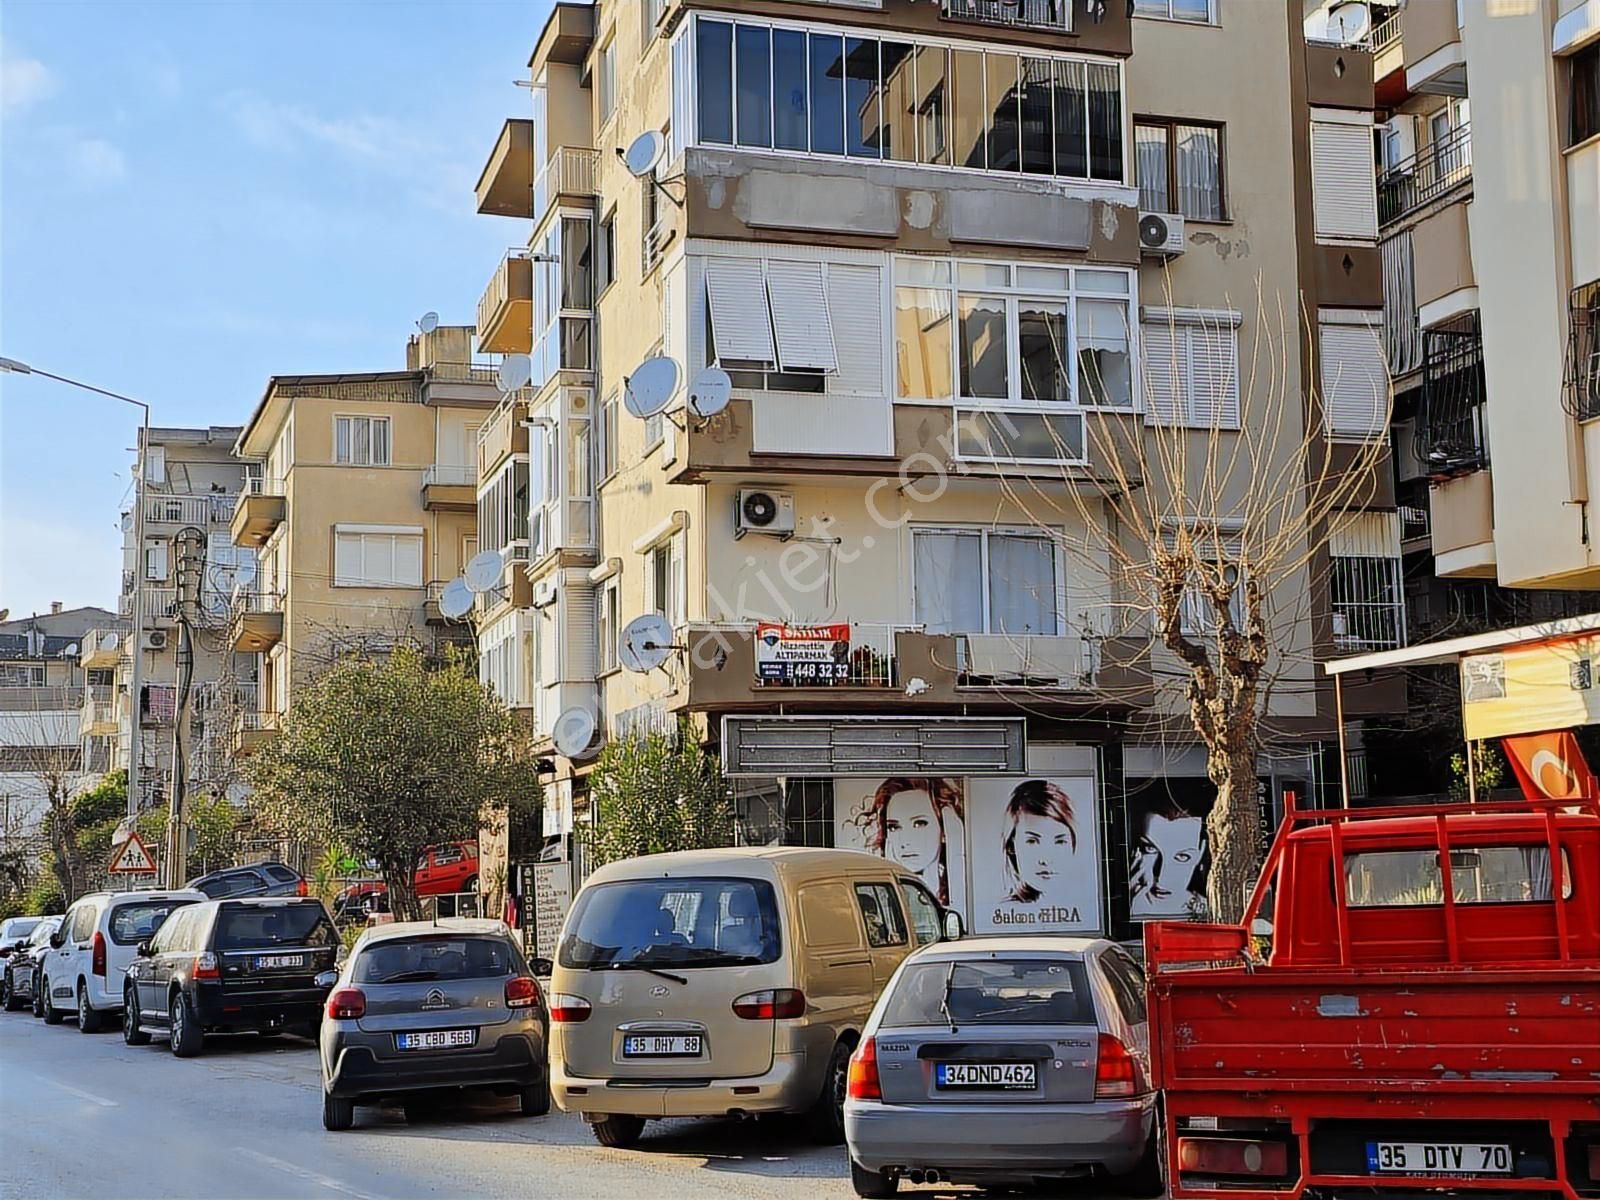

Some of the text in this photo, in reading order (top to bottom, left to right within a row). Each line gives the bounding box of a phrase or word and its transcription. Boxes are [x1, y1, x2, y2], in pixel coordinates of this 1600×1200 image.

[795, 664, 816, 678] 448
[819, 664, 832, 678] 32
[835, 664, 848, 678] 32
[407, 1035, 420, 1046] 35
[632, 1038, 646, 1051] 35
[684, 1037, 698, 1051] 88
[1380, 1145, 1407, 1168] 35
[1423, 1146, 1463, 1169] DTV
[1480, 1146, 1507, 1170] 70
